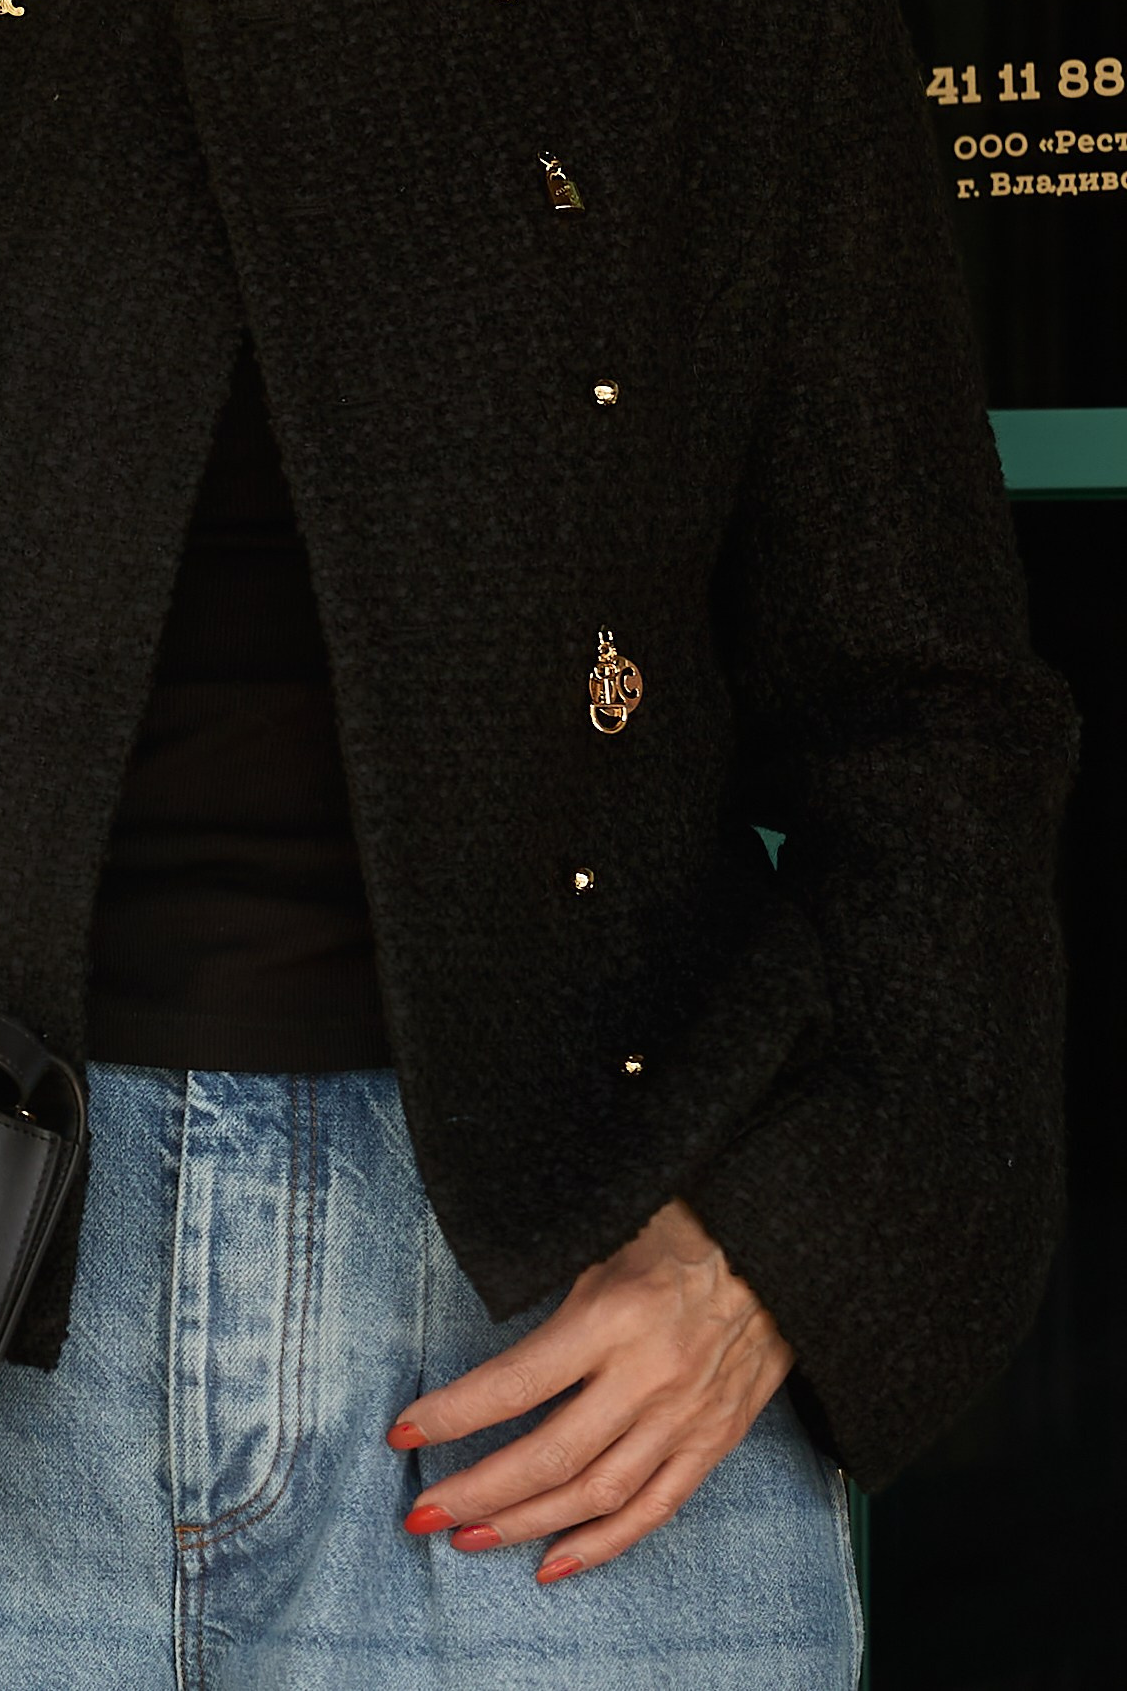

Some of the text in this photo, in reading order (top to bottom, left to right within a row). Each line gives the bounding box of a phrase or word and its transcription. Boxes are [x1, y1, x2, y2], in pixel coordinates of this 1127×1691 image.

[925, 56, 1125, 106] 41 11 88
[953, 132, 1029, 160] ООО
[956, 178, 980, 199] г.
